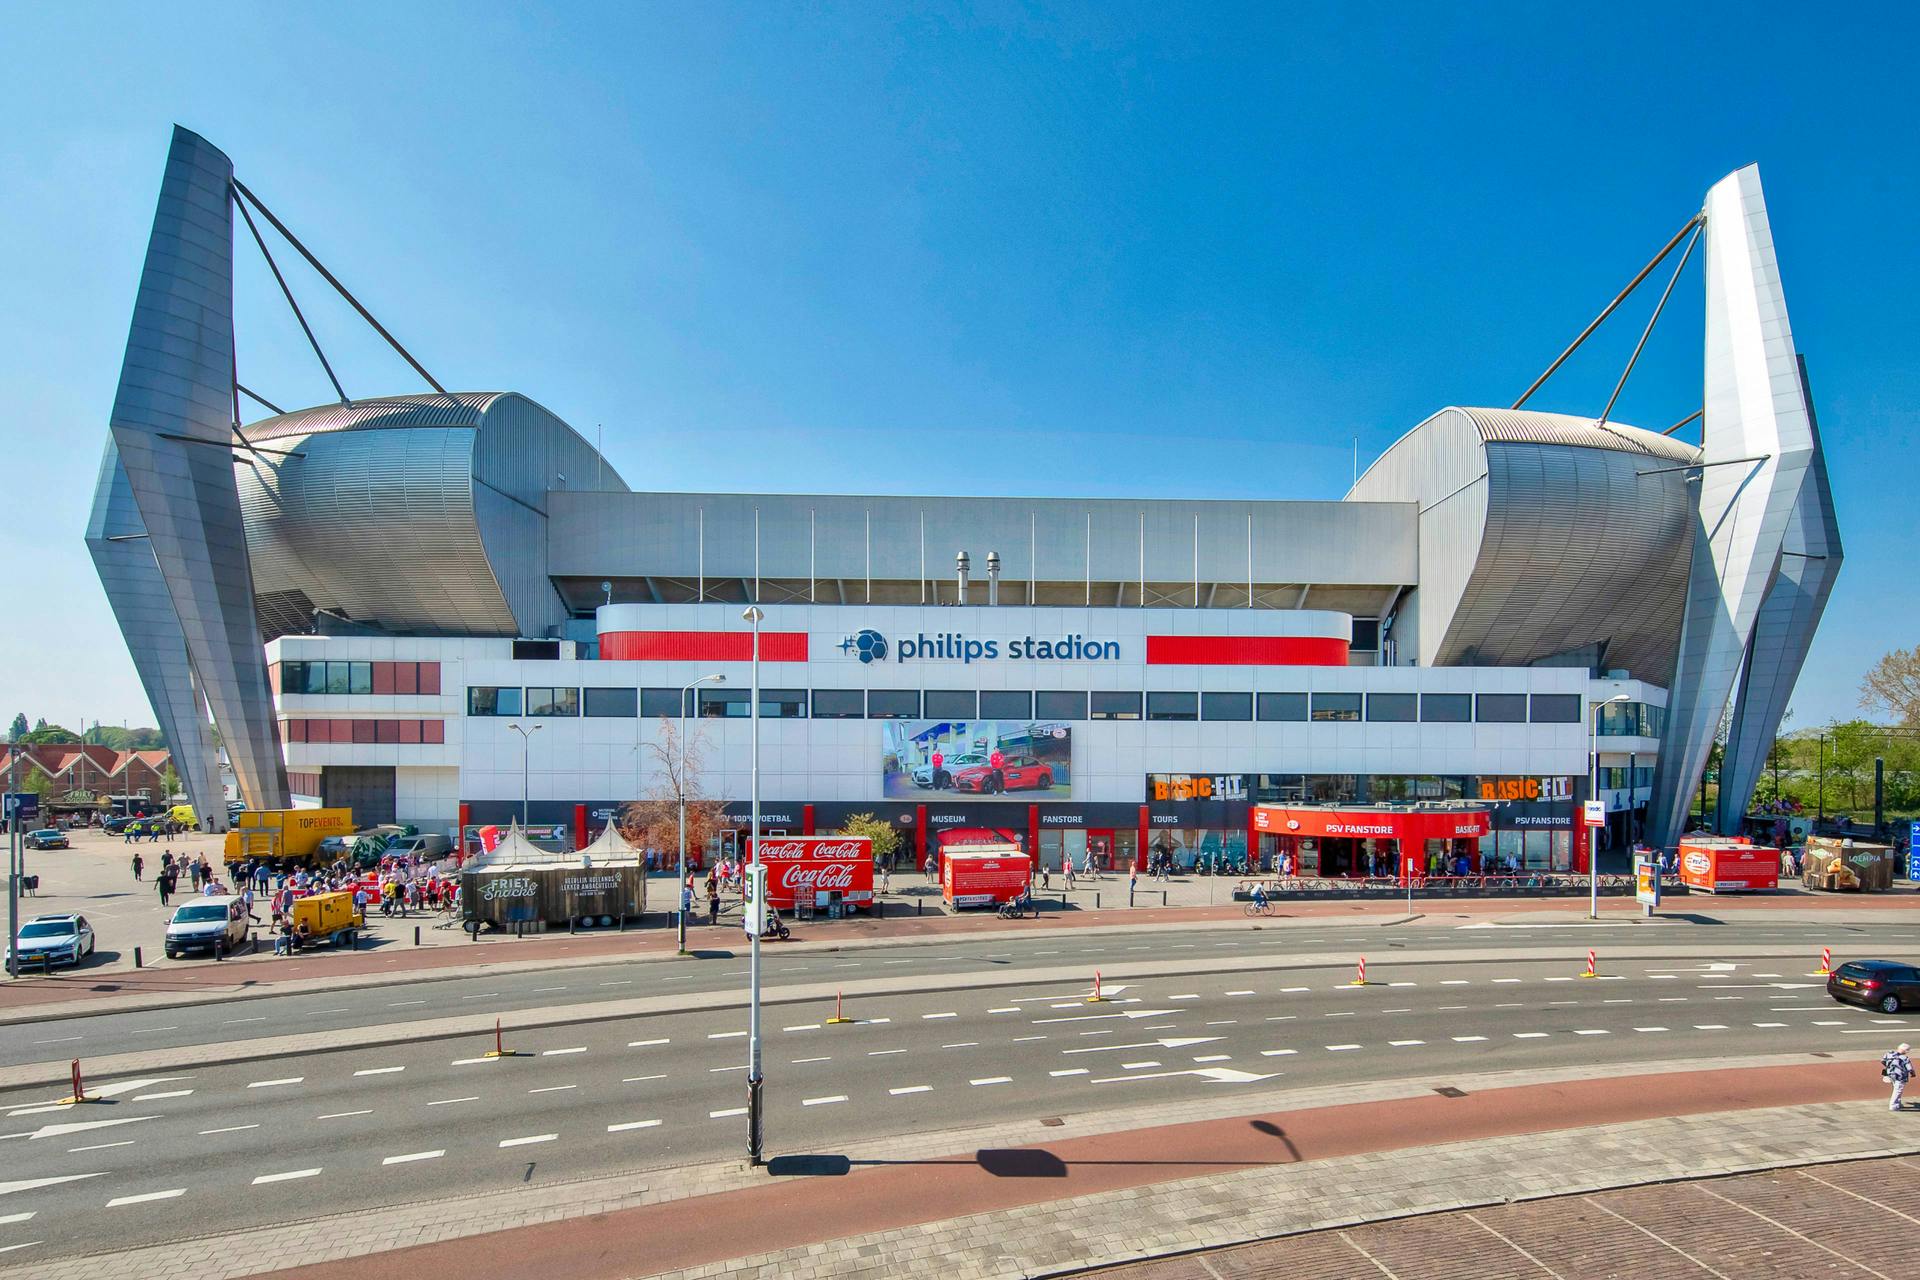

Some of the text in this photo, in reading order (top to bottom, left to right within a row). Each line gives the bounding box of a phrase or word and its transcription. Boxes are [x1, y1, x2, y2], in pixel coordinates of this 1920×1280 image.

[898, 632, 1121, 664] philips stadion
[931, 815, 966, 823] MUSEUM
[1042, 815, 1083, 823] FANSTORE
[1152, 815, 1178, 823] TOURS
[1515, 816, 1571, 825] PSV FANSTORE
[1326, 824, 1393, 834] PSV FANSTORE
[782, 864, 857, 888] Coca-Cola
[490, 878, 531, 889] FRIET
